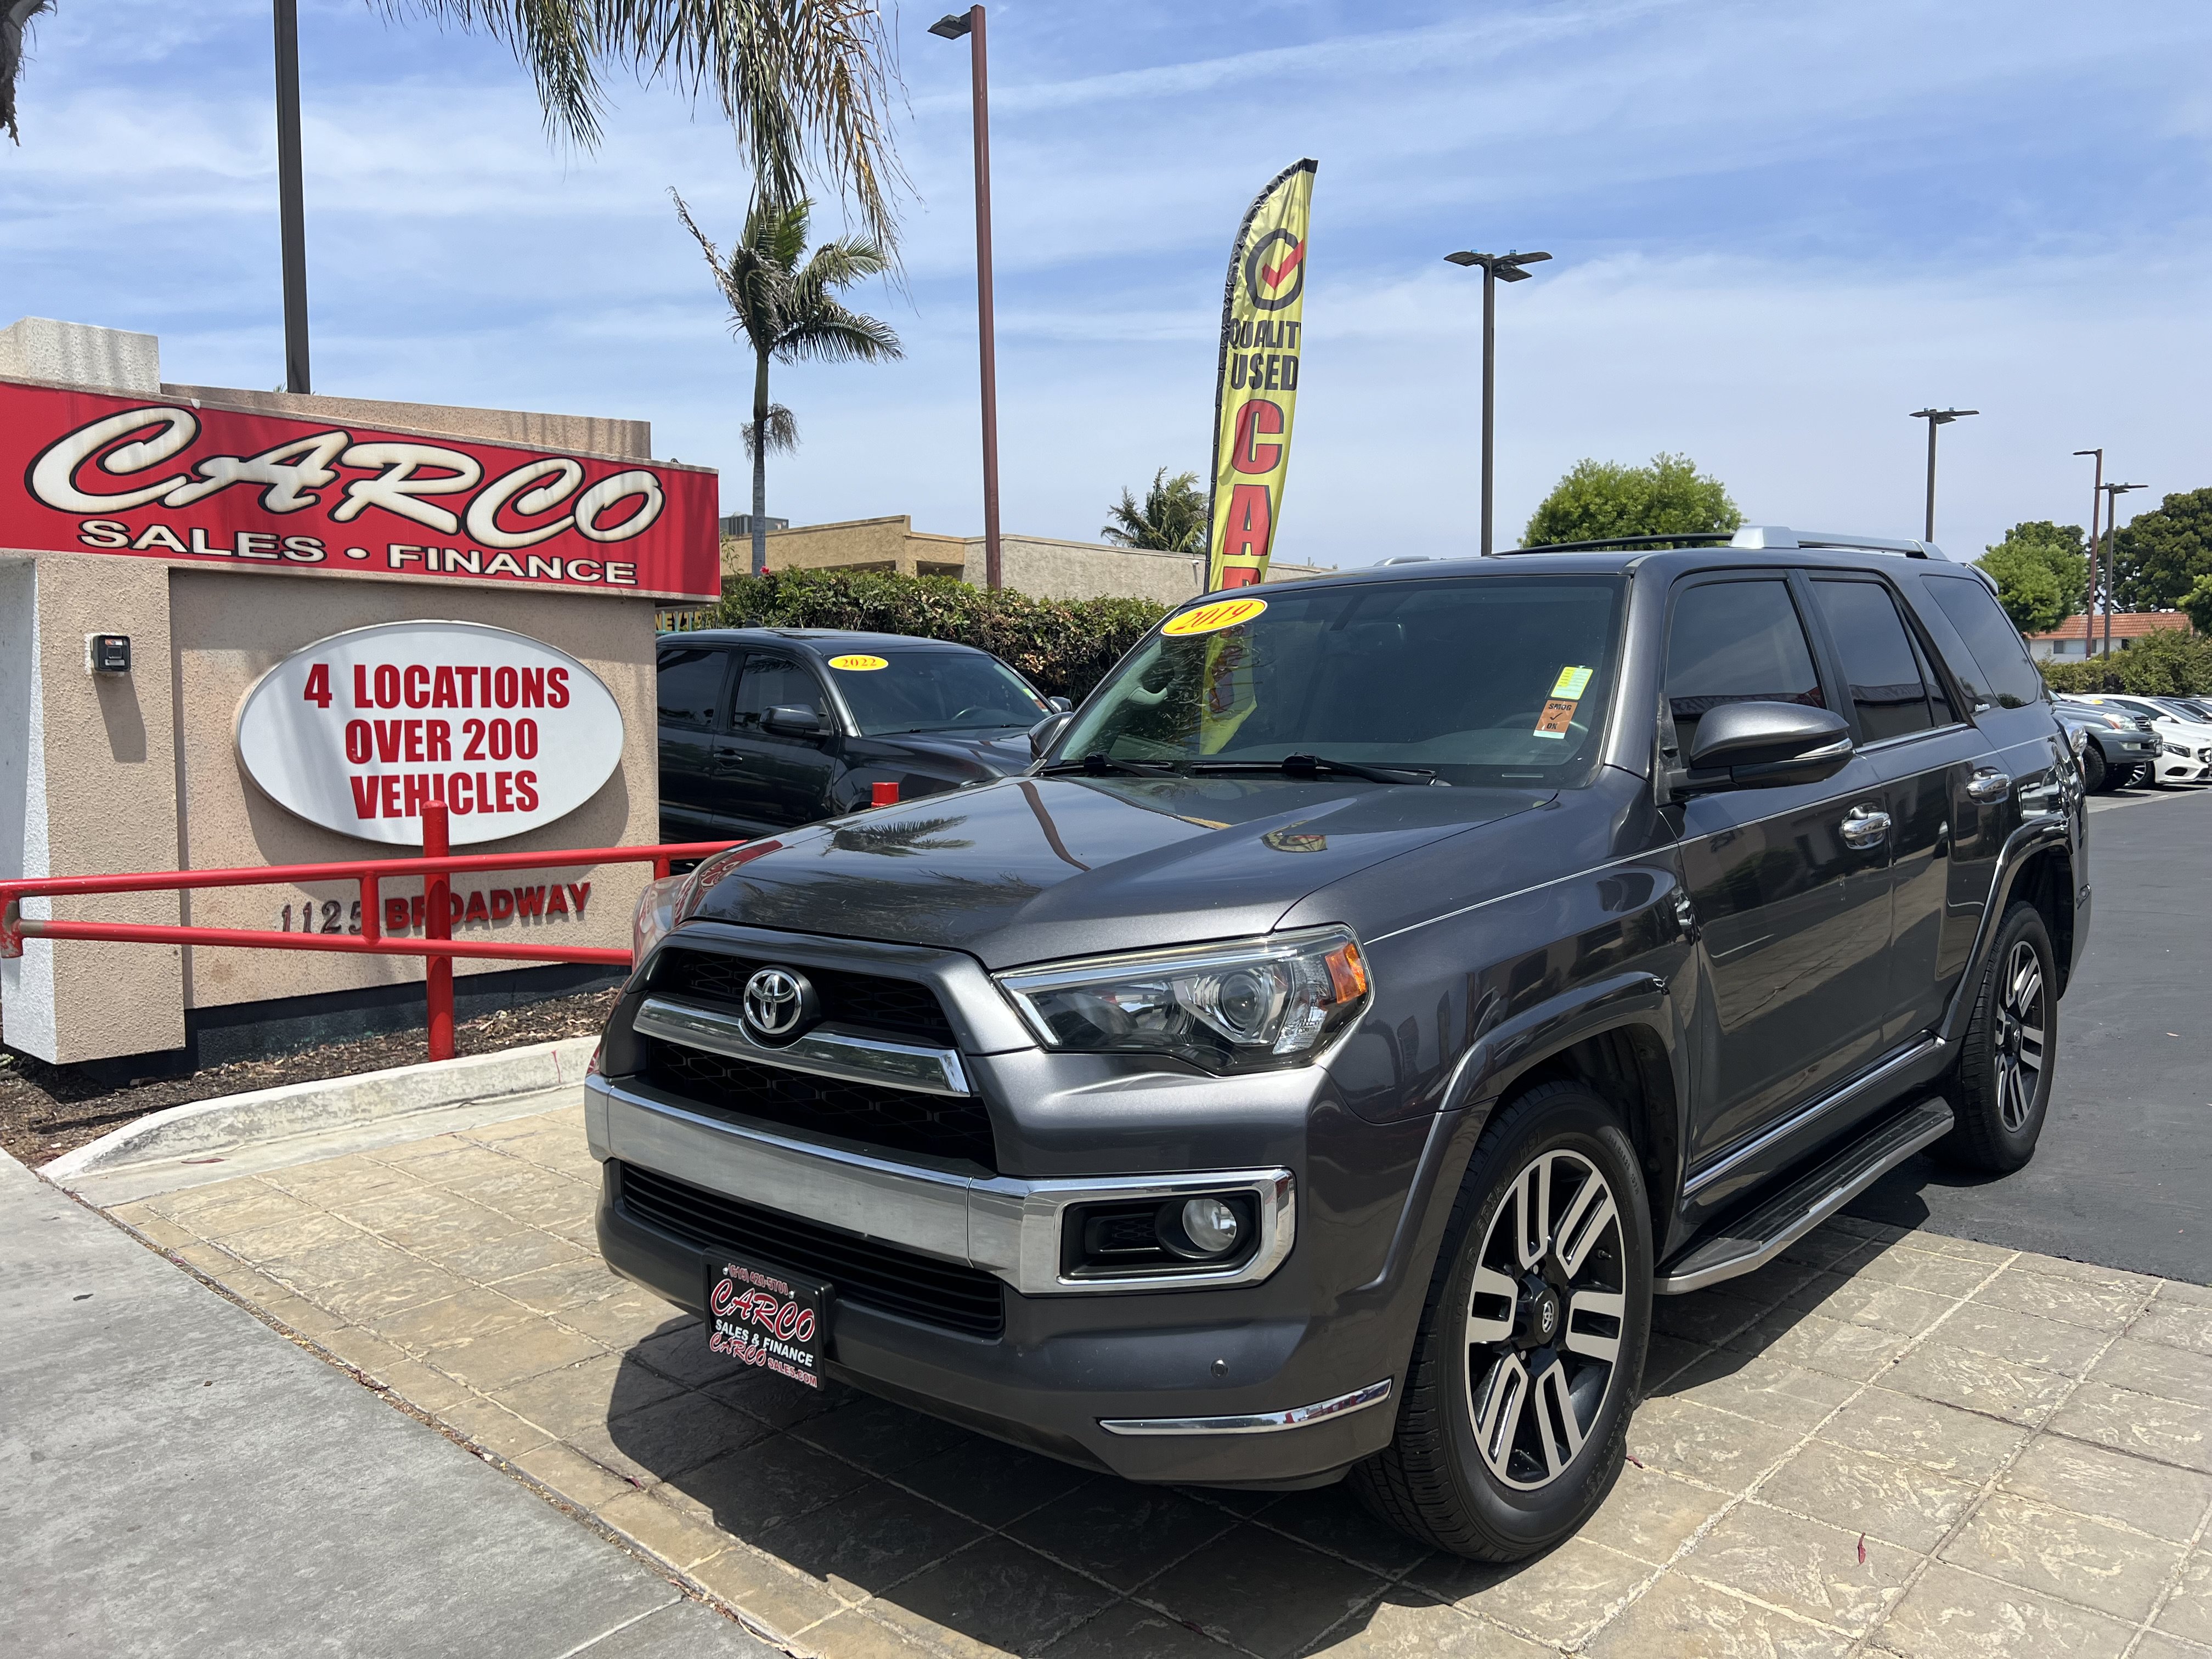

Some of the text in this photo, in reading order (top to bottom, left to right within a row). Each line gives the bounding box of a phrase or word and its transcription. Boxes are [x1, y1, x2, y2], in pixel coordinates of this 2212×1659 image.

[1228, 318, 1301, 349] QUALIT
[1231, 353, 1299, 391] USED
[24, 402, 665, 548] CARCO
[78, 518, 637, 586] SALES FINANCE
[1172, 603, 1253, 631] 2019
[842, 658, 877, 667] 2022
[304, 663, 570, 709] 4 LOCATIONS
[345, 718, 538, 764] OVER 200
[350, 770, 539, 819] VEHICLES
[710, 1278, 815, 1342] CARCO
[715, 1319, 814, 1367] SALES & FINANCE
